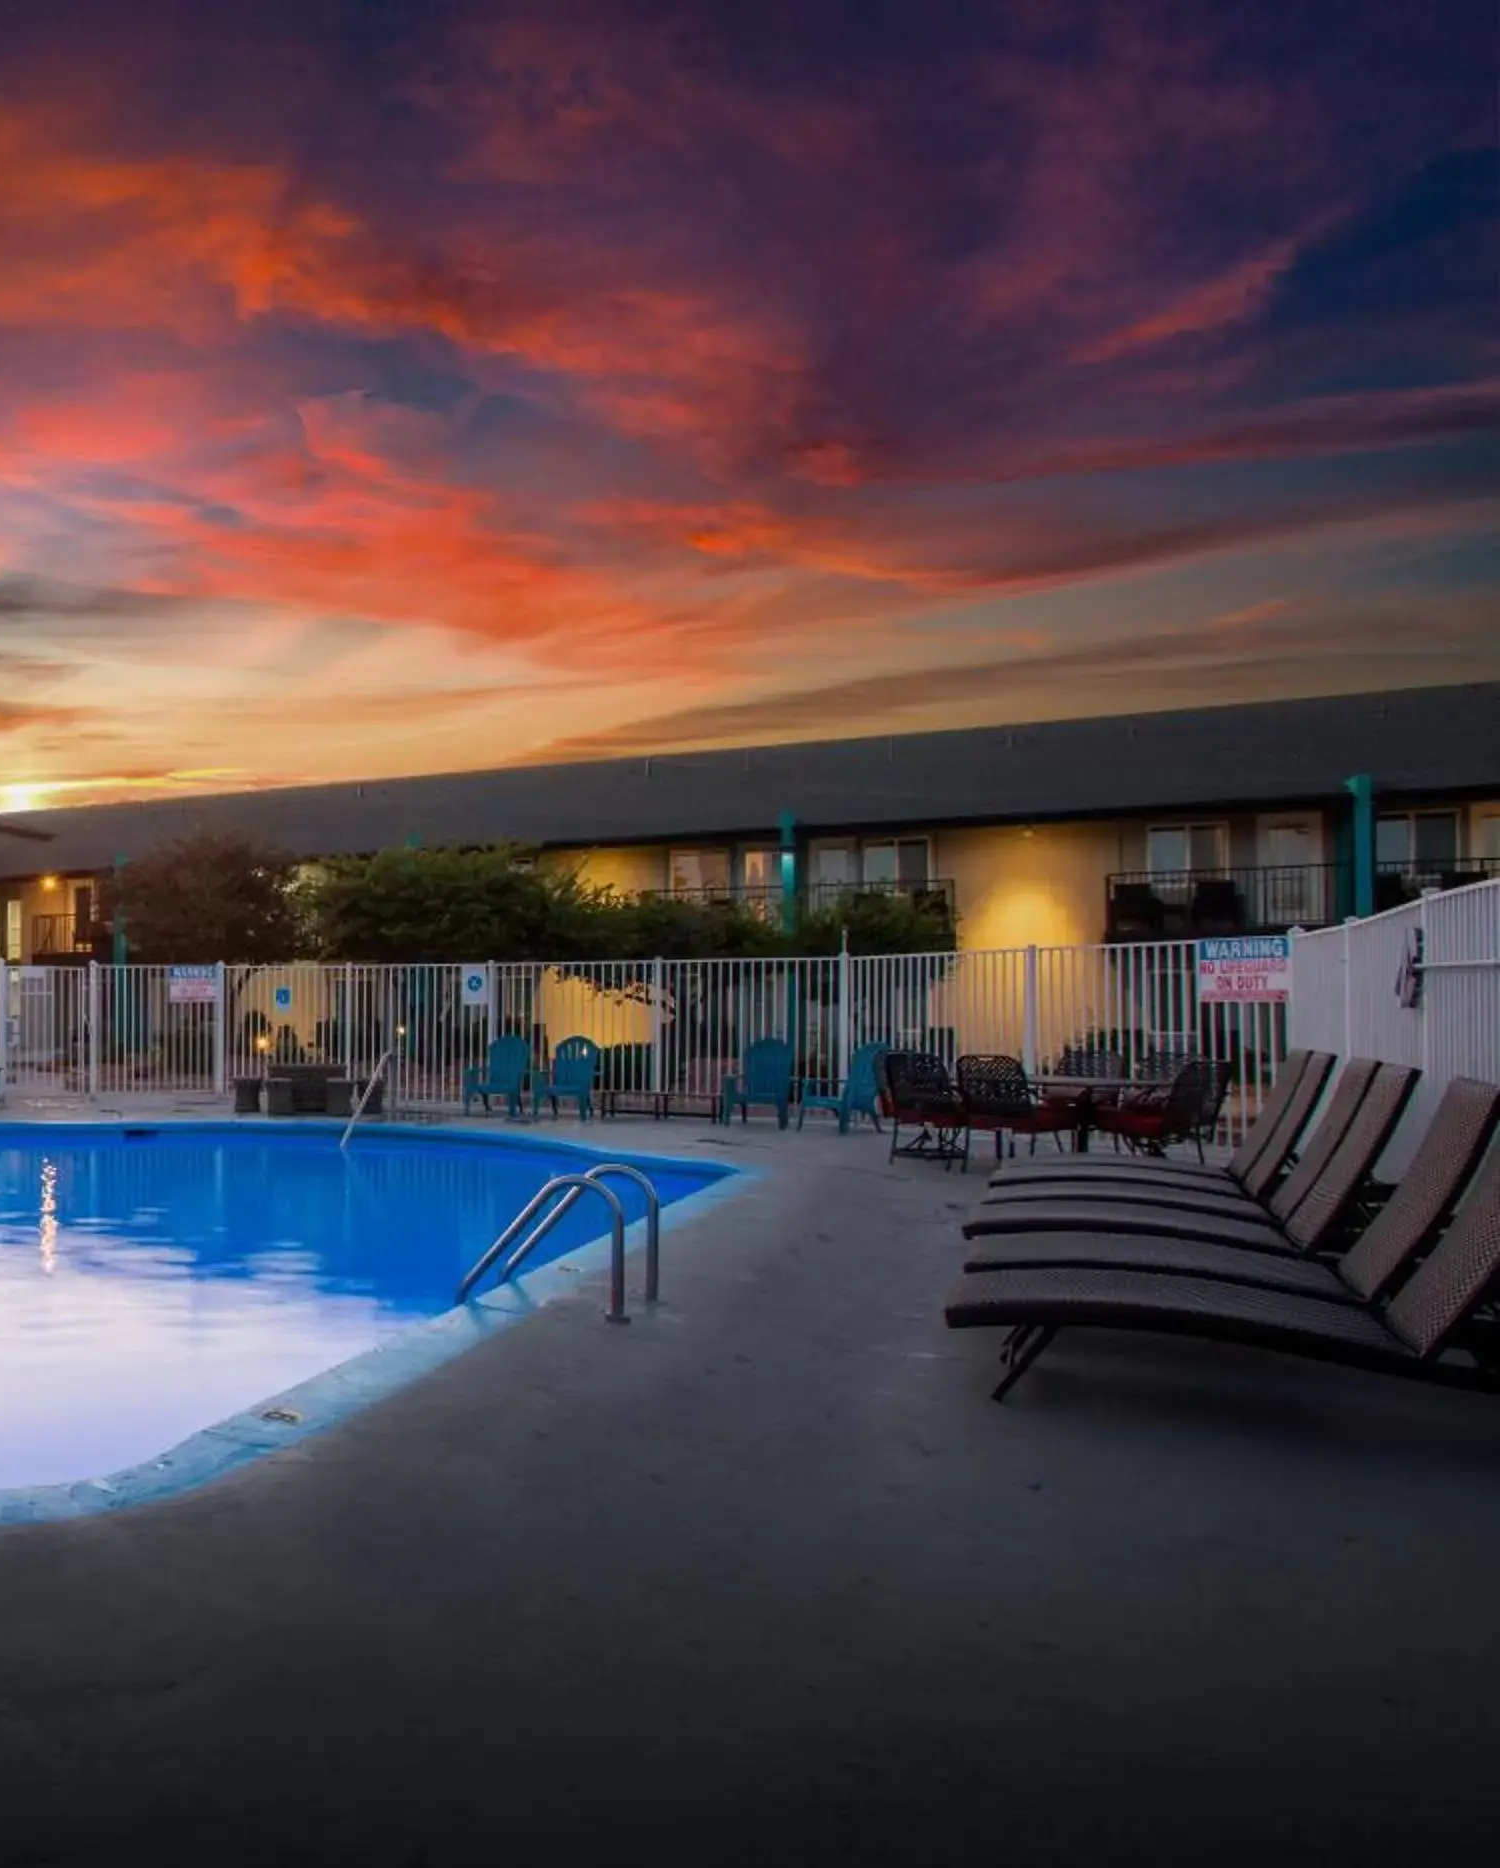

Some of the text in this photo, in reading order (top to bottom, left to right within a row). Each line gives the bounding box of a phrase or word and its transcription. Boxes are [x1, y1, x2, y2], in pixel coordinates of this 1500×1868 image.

[1205, 939, 1284, 958] WARNING
[1216, 975, 1269, 989] ON DUTY
